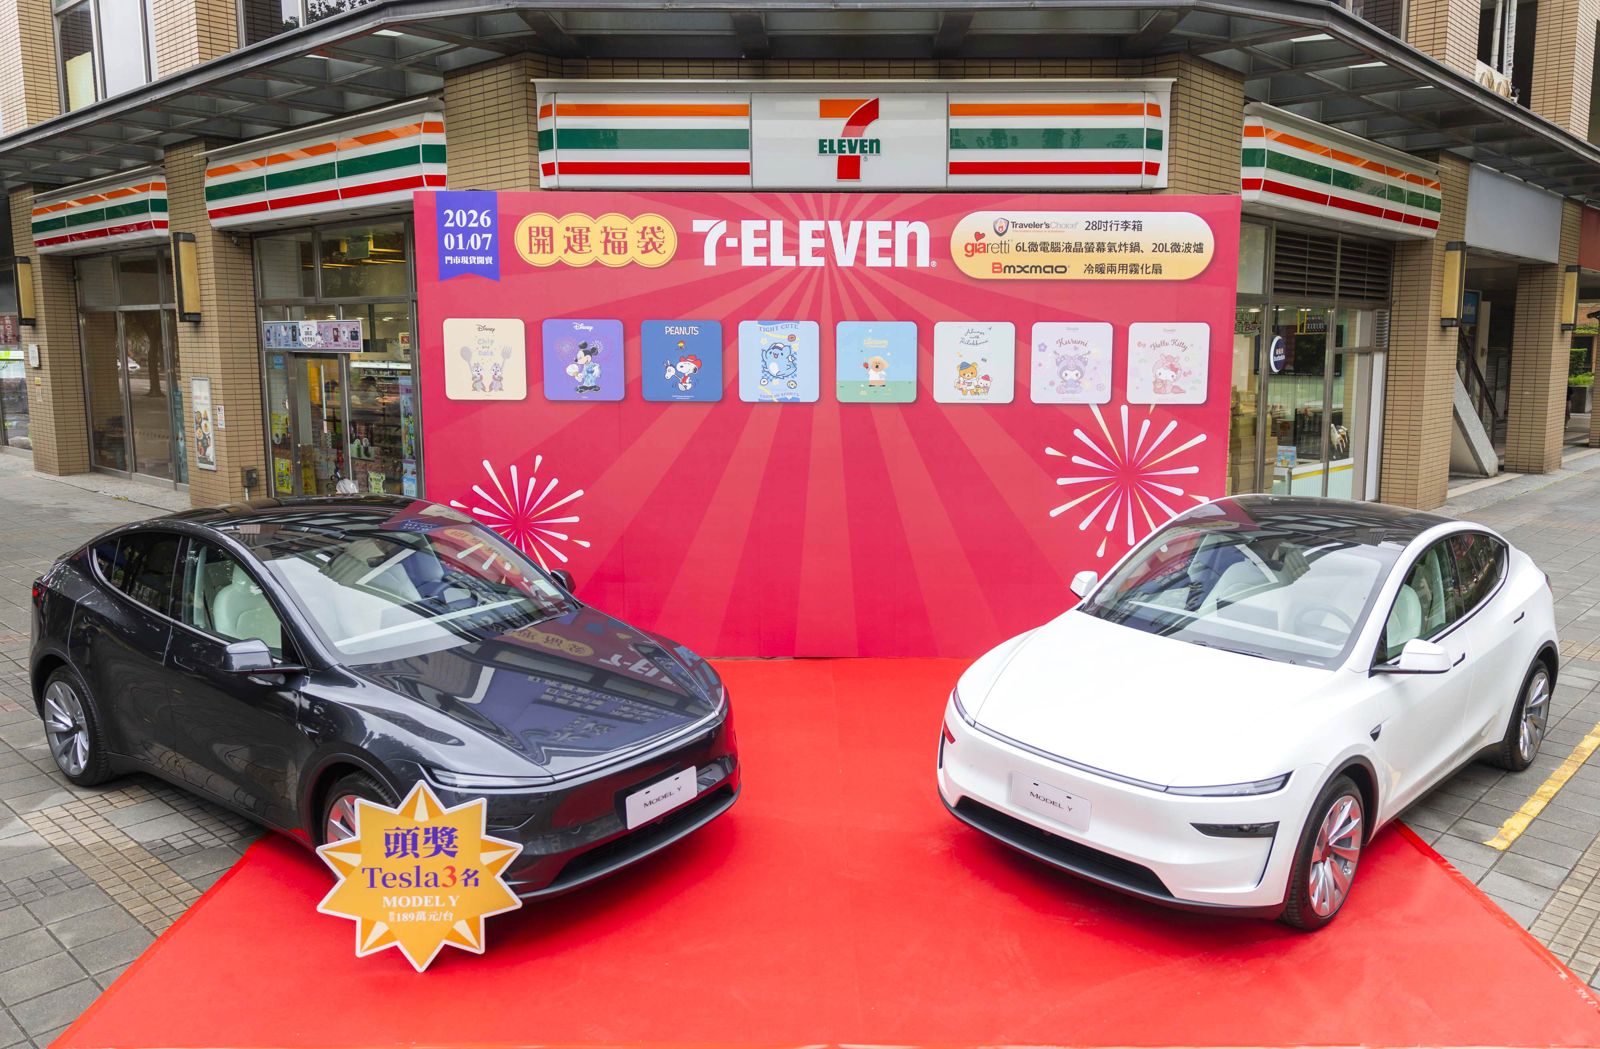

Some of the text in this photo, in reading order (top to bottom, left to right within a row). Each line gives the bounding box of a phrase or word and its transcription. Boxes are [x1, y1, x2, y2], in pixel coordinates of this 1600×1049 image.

[444, 209, 492, 228] 2026
[1084, 220, 1143, 232] 28吋行李箱
[444, 233, 493, 251] 01/07
[527, 226, 666, 256] 開運福袋
[964, 240, 1010, 257] giaretti
[991, 262, 1163, 275] Bmxmao 冷暖兩用霧化扇
[475, 324, 496, 333] Disney
[573, 322, 594, 332] Disney
[664, 326, 699, 336] PEANUTS
[1150, 338, 1189, 353] Hello Kitty
[643, 791, 675, 808] MODEL
[1029, 791, 1065, 810] MODEL
[383, 826, 459, 859] 頭獎
[383, 895, 460, 908] MODEL Y
